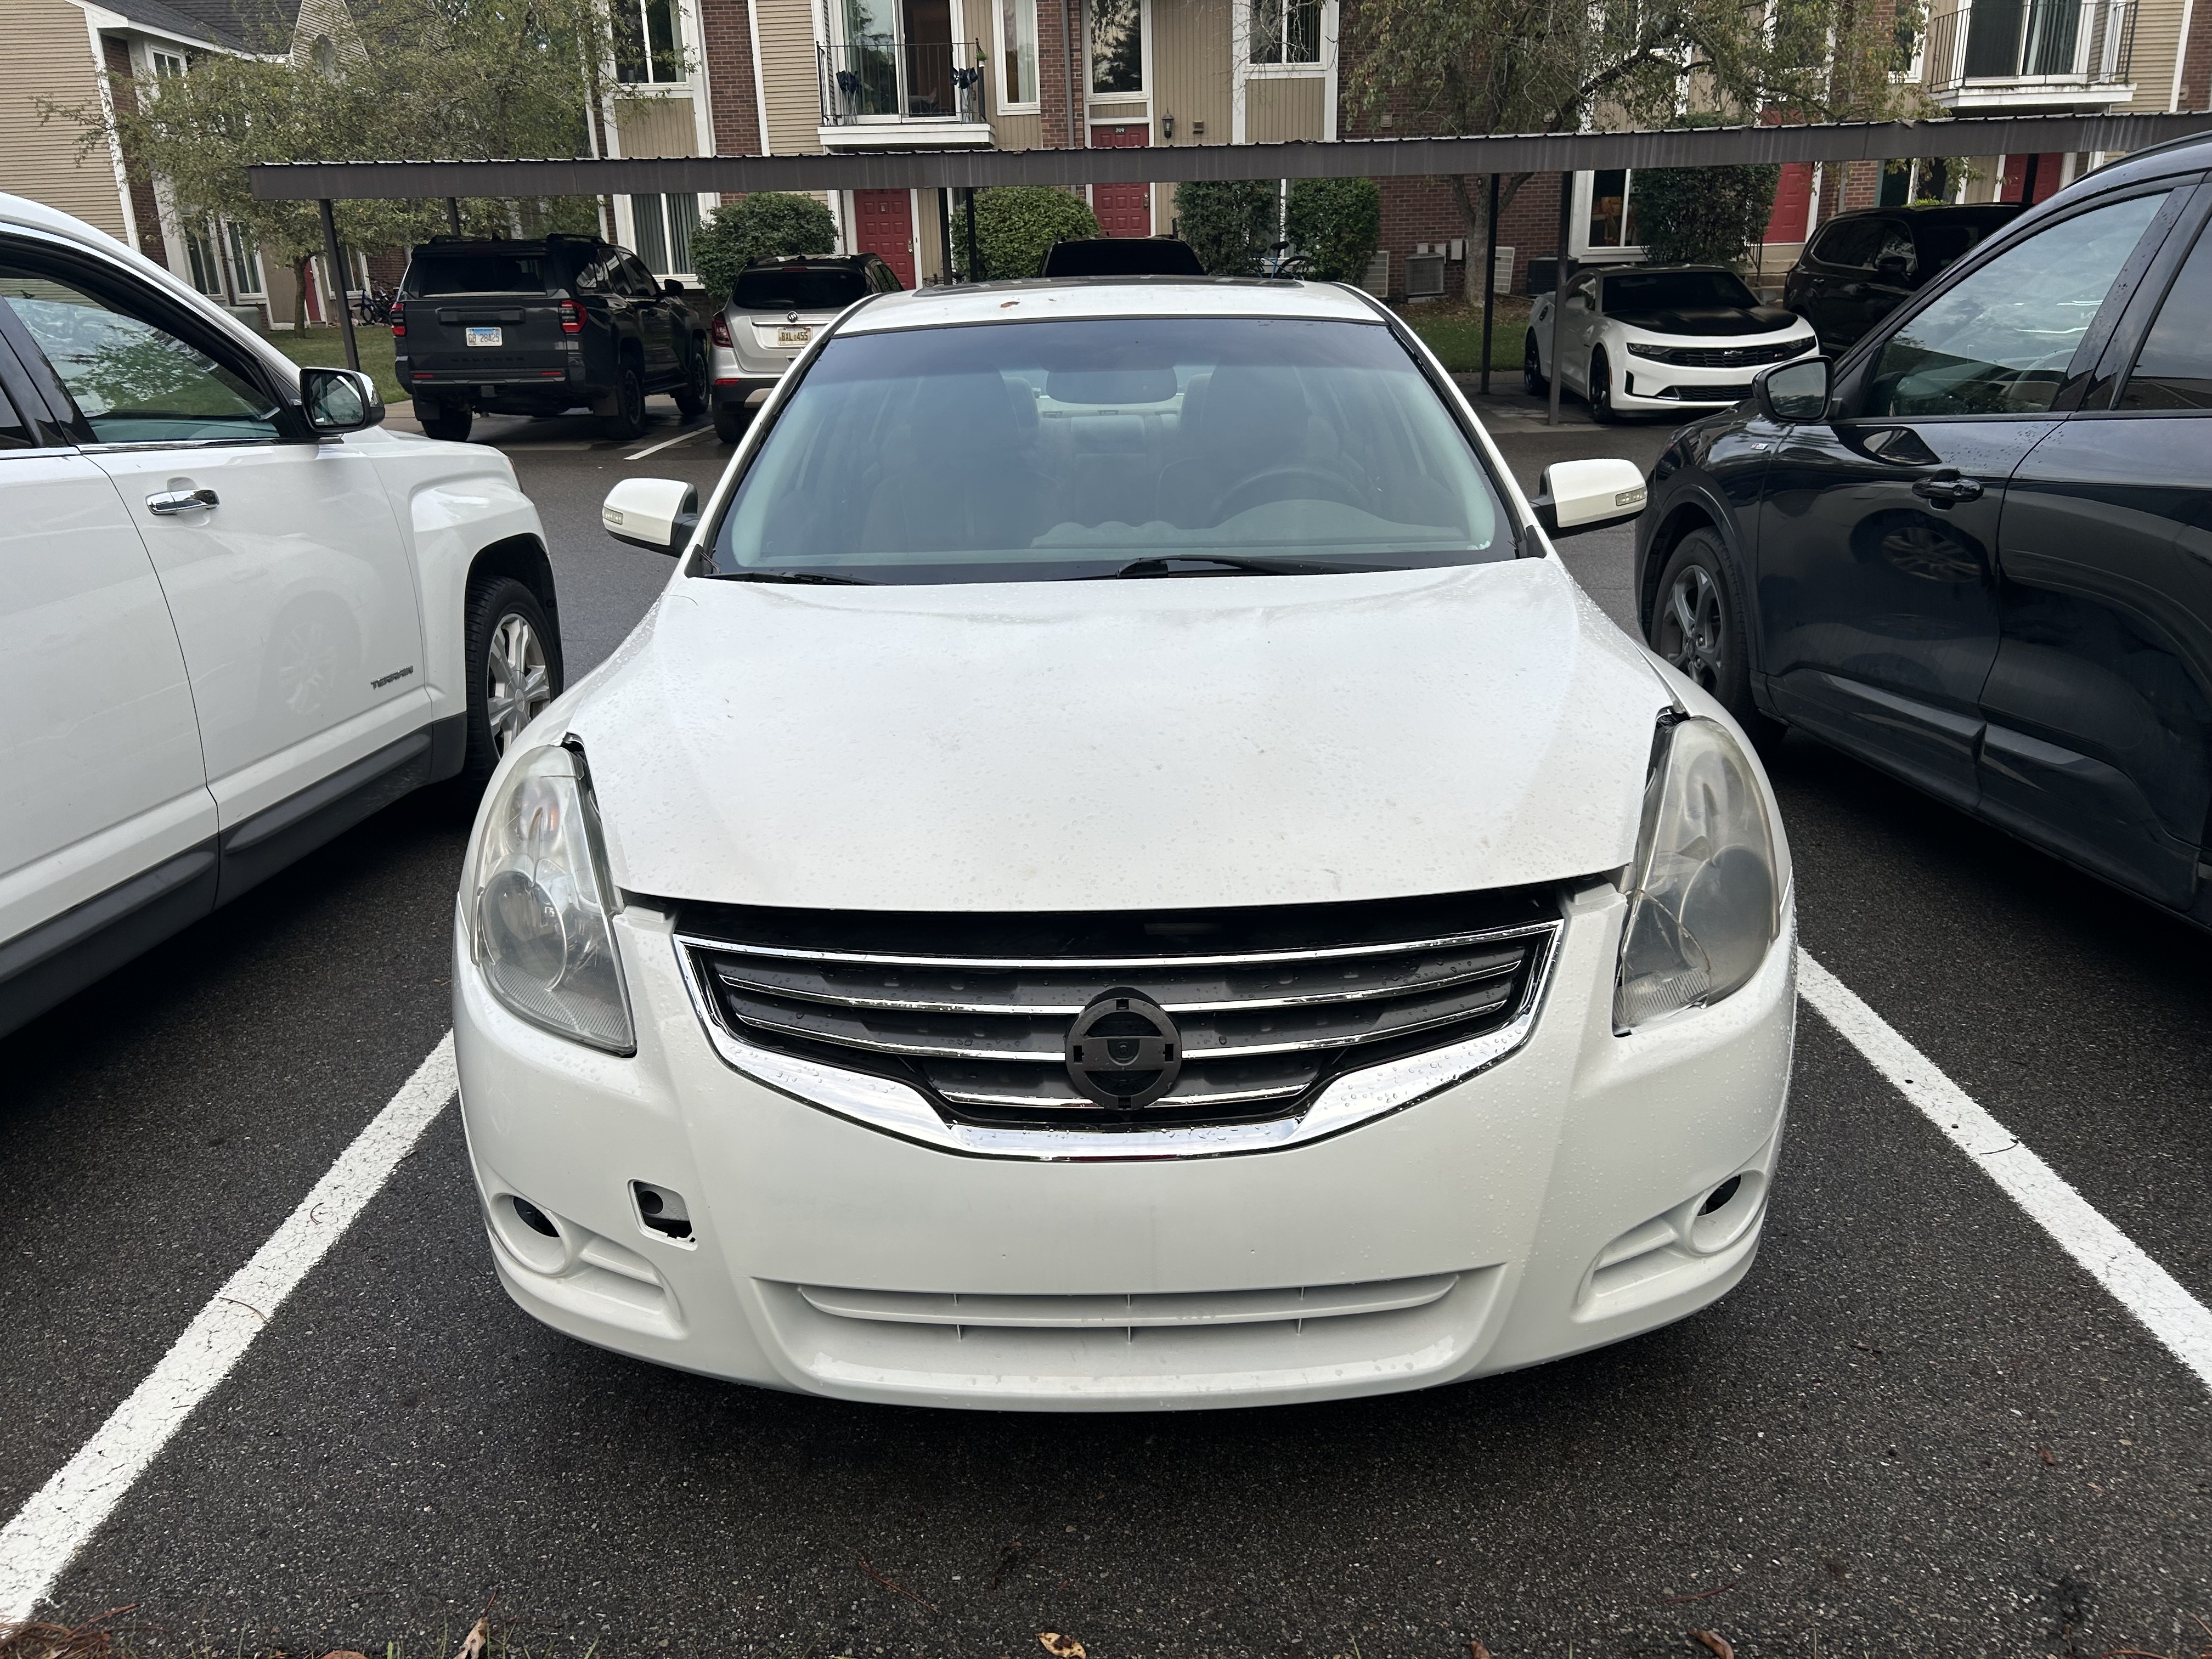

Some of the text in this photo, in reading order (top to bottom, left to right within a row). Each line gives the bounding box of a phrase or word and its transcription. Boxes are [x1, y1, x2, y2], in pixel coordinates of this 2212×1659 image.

[479, 333, 500, 343] 28425
[781, 331, 808, 341] BXL 455
[370, 665, 414, 690] TERRAIN
